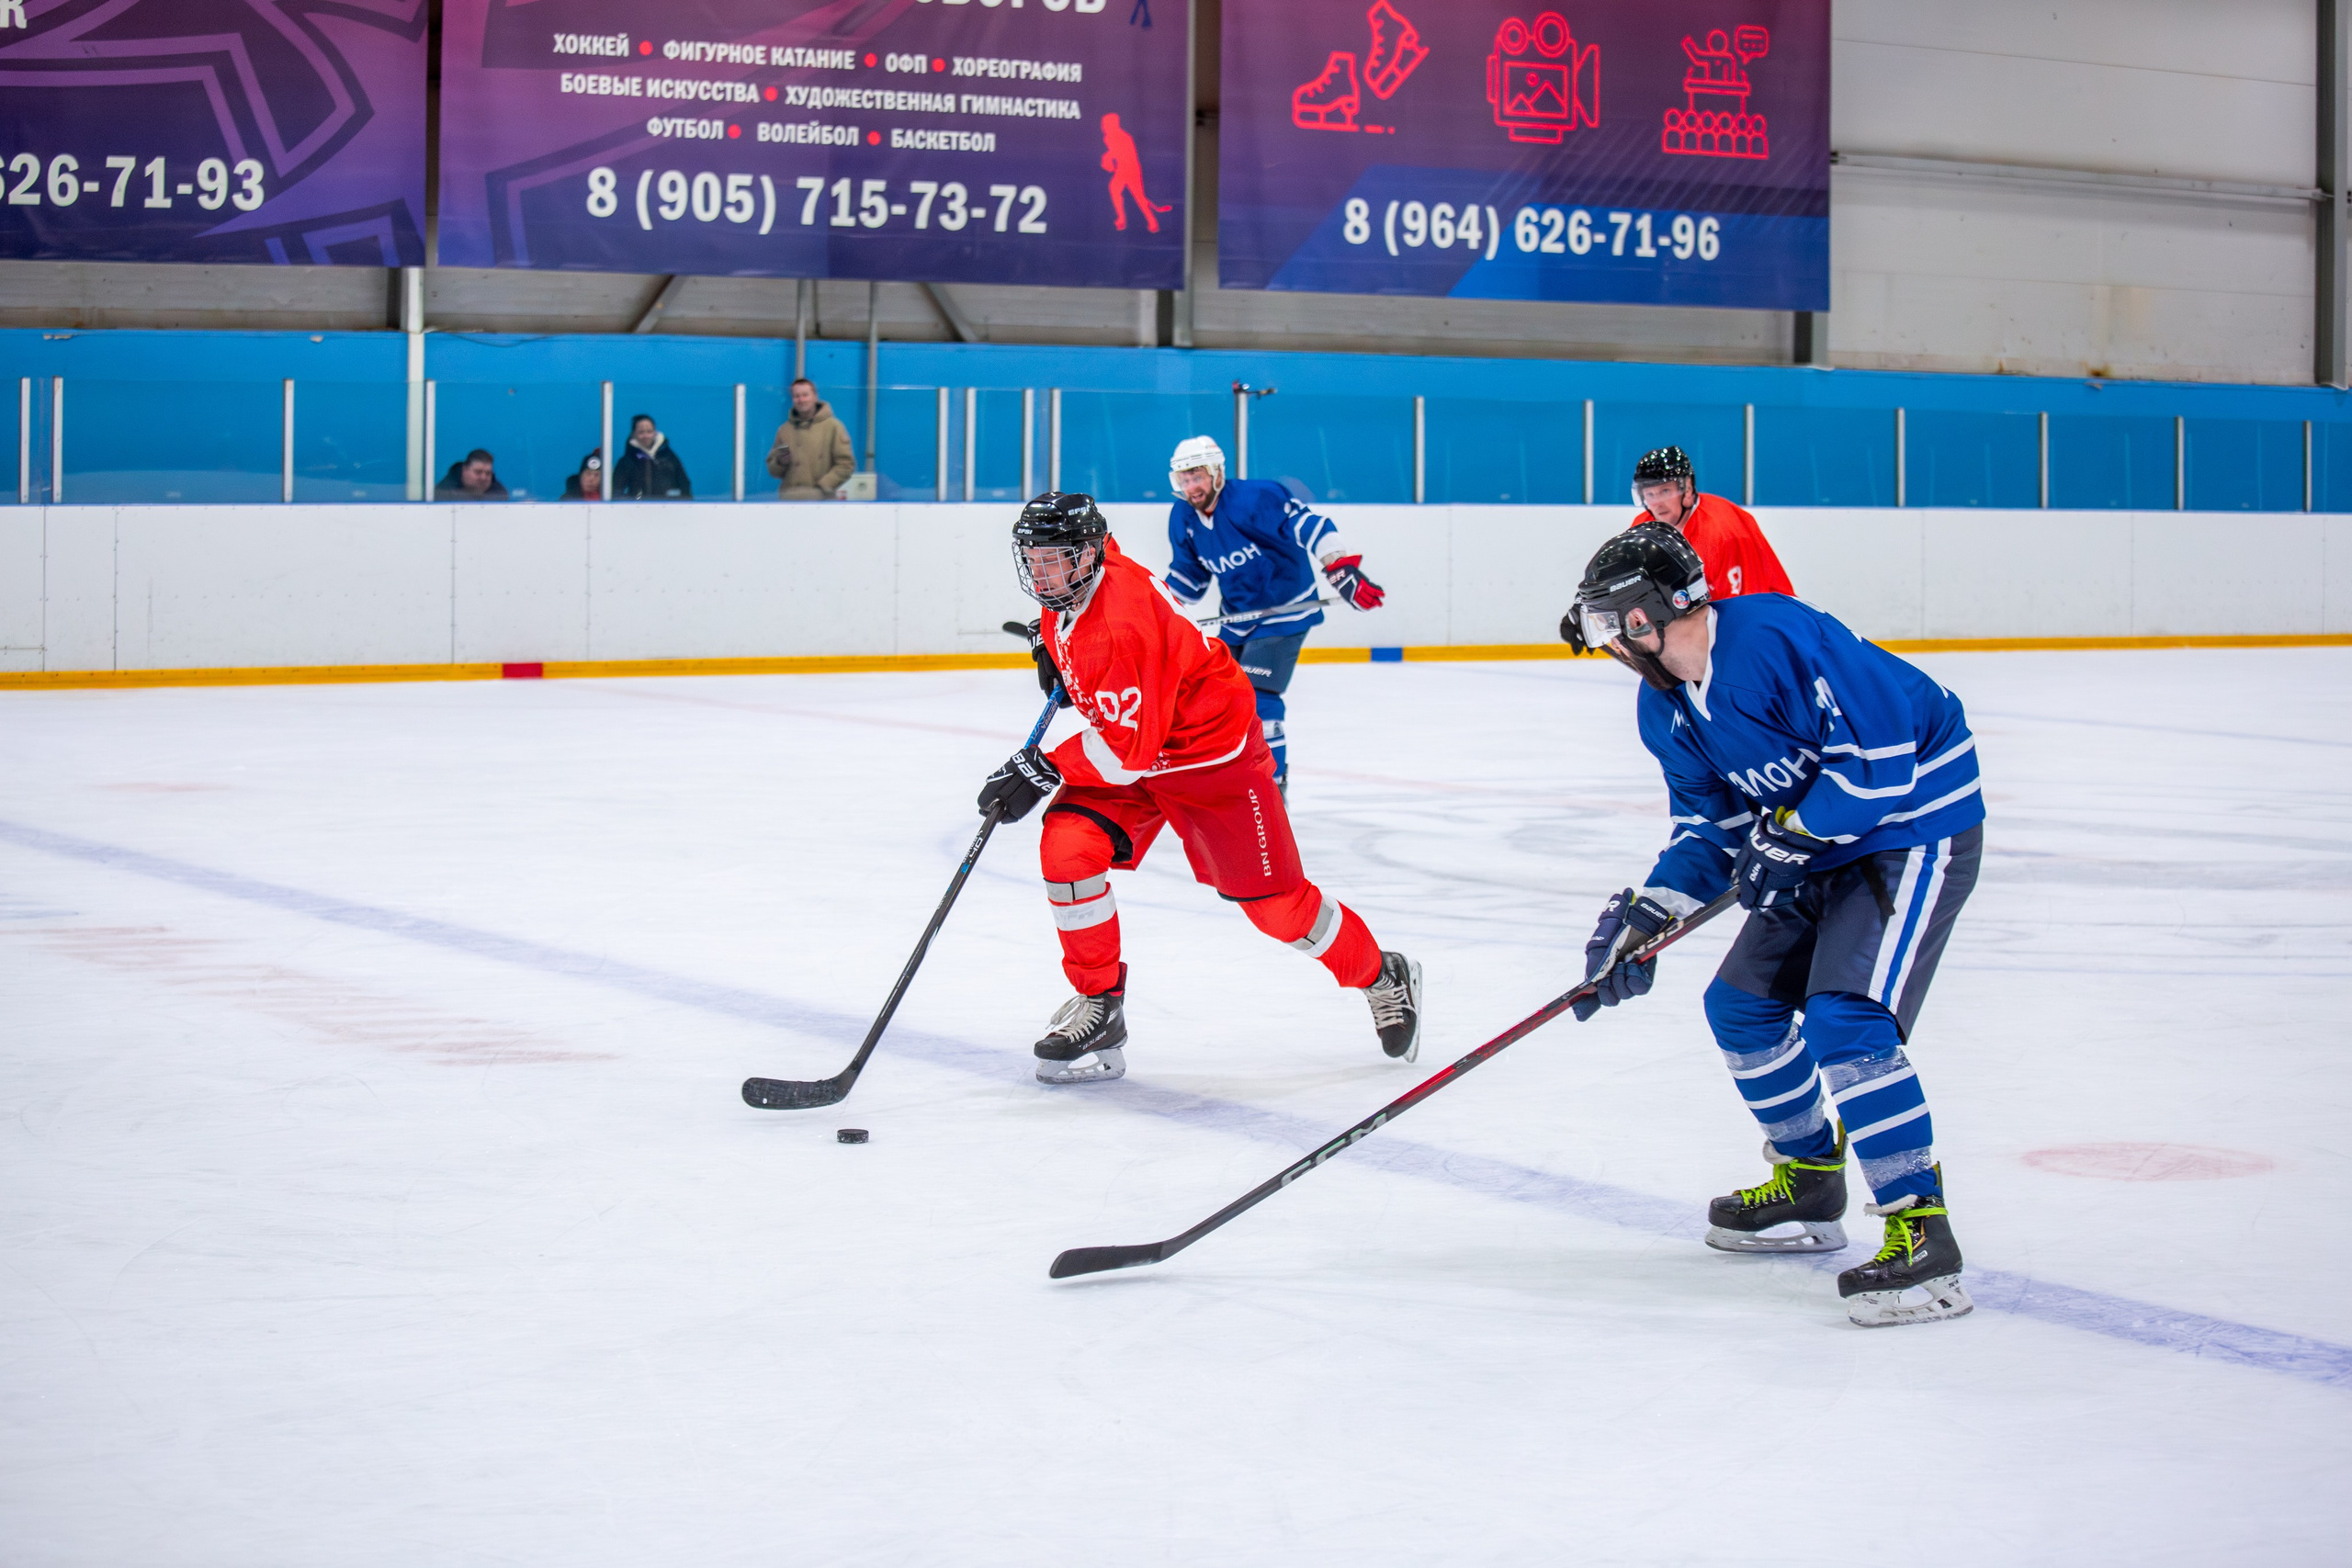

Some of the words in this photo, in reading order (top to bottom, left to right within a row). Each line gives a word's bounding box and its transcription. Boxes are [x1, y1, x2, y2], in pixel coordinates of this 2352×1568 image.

[553, 33, 629, 57] ХОККЕЙ
[662, 39, 767, 65] ФИГУРНОЕ
[770, 46, 855, 70] КАТАНИЕ
[885, 52, 928, 74] ОФП
[952, 56, 1082, 83] ХОРЕОГРАФИЯ
[560, 73, 642, 96] БОЕВЫЕ
[646, 77, 760, 104] ИСКУССТВА
[785, 85, 956, 113] ХУДОЖЕСТВЕННАЯ
[960, 94, 1081, 119] ГИМНАСТИКА
[646, 116, 724, 141] ФУТБОЛ
[757, 120, 859, 146] ВОЛЕЙБОЛ
[891, 128, 996, 152] БАСКЕТБОЛ
[586, 166, 617, 218] 8
[636, 169, 776, 235] (905)
[796, 176, 1047, 233] 715-73-72
[1343, 197, 1371, 244] 8
[1384, 200, 1500, 261] (964)
[1515, 207, 1720, 261] 626-71-96
[1610, 575, 1642, 592] BAUER
[1012, 752, 1056, 793] BAUE
[1249, 789, 1267, 849] GROUP
[1261, 852, 1272, 876] BN
[1749, 822, 1811, 865] UER
[1640, 902, 1668, 920] BAUER
